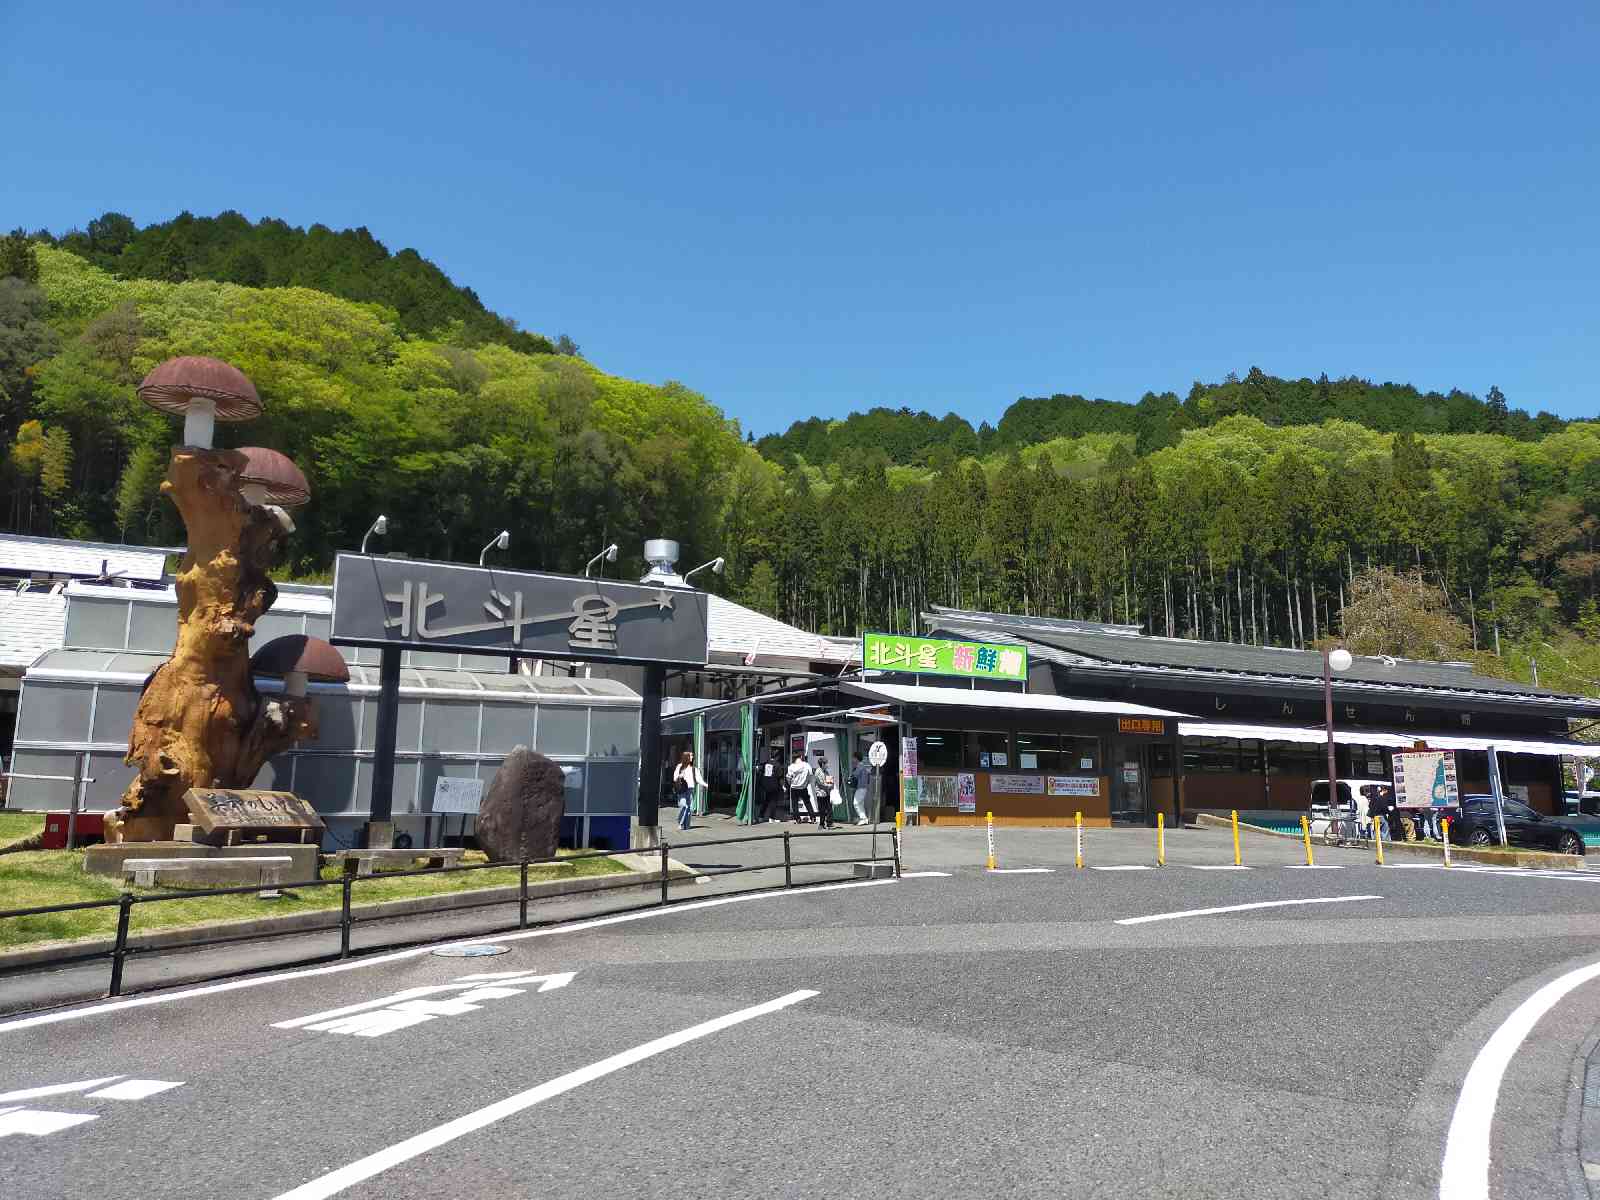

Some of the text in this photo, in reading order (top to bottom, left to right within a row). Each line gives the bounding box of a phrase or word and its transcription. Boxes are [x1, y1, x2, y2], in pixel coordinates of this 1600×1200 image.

[384, 581, 620, 650] 北斗星
[870, 640, 937, 670] 北斗星
